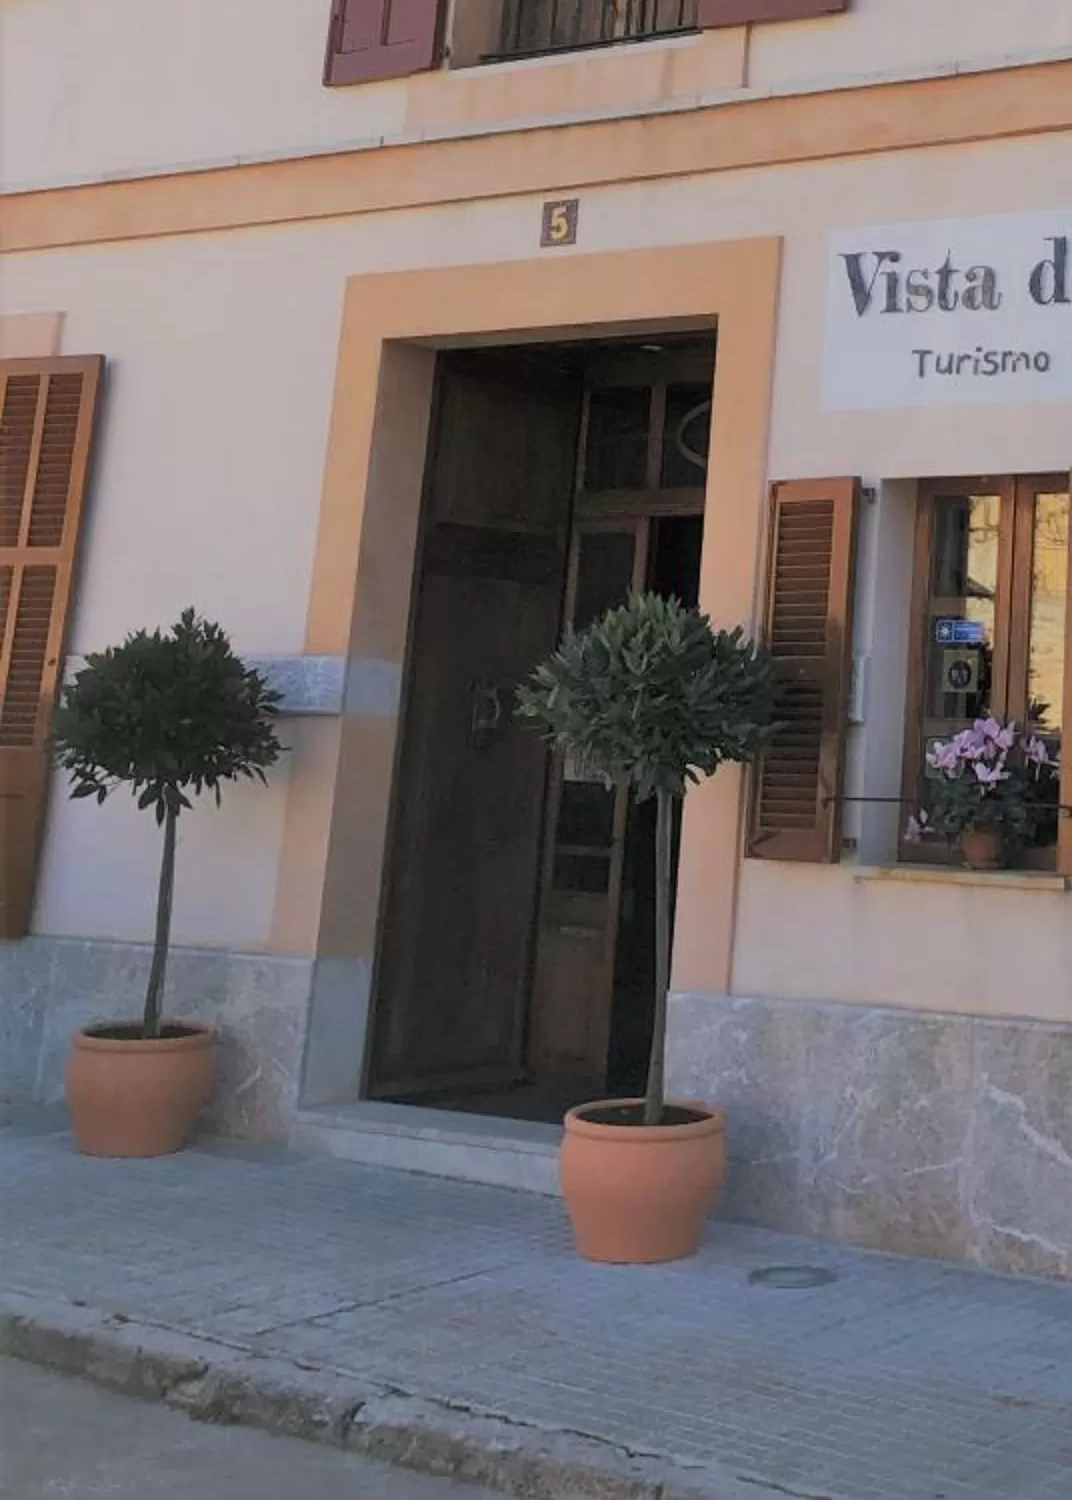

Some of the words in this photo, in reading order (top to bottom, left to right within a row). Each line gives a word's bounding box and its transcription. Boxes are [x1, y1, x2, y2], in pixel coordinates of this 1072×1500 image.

[550, 206, 568, 239] 5
[839, 248, 1003, 317] Vista
[911, 348, 1052, 378] Turismo
